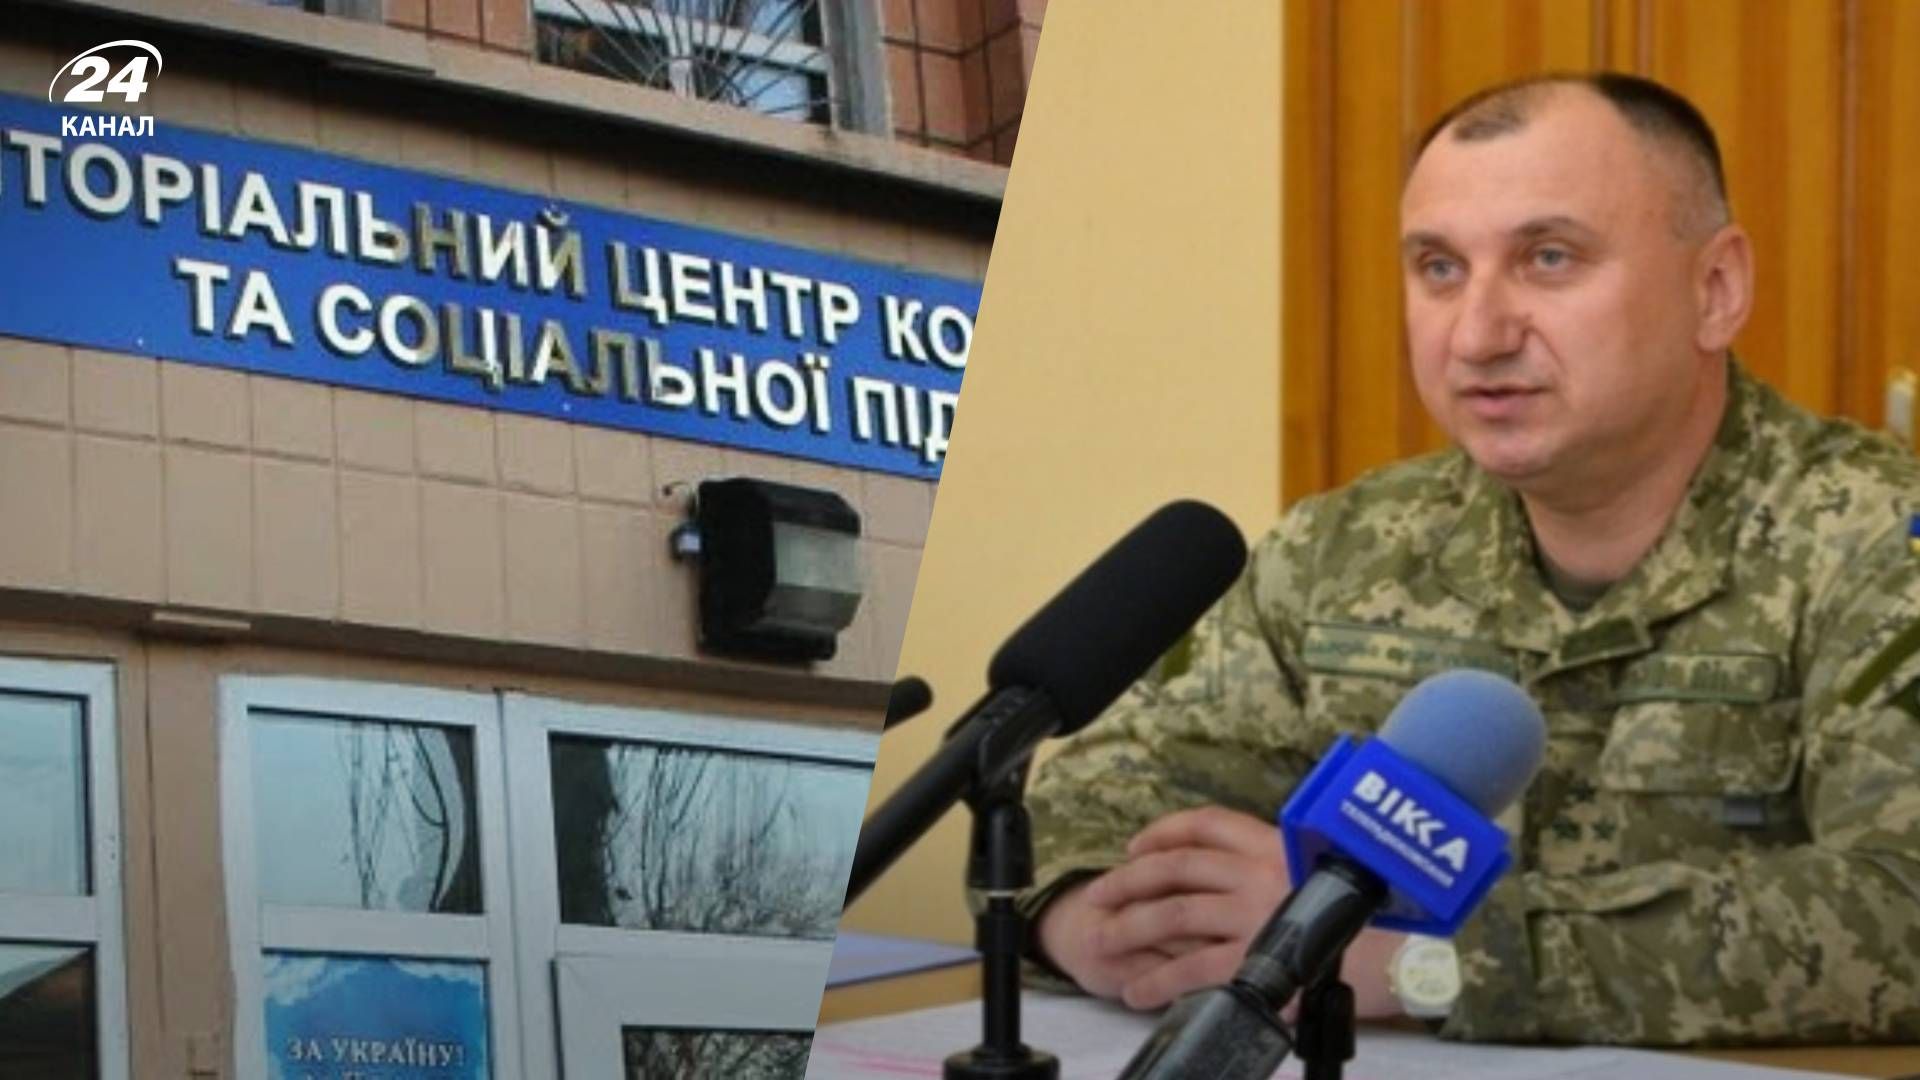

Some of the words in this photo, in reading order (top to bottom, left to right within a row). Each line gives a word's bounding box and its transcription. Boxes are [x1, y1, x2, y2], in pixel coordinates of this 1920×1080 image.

[0, 129, 585, 297] ТОРІАЛЬНИЙ
[612, 241, 859, 346] ЦЕНТР
[174, 257, 294, 346] ТА
[317, 283, 831, 434] СОЦІАЛЬНОЇ
[286, 1038, 323, 1061] ЗА
